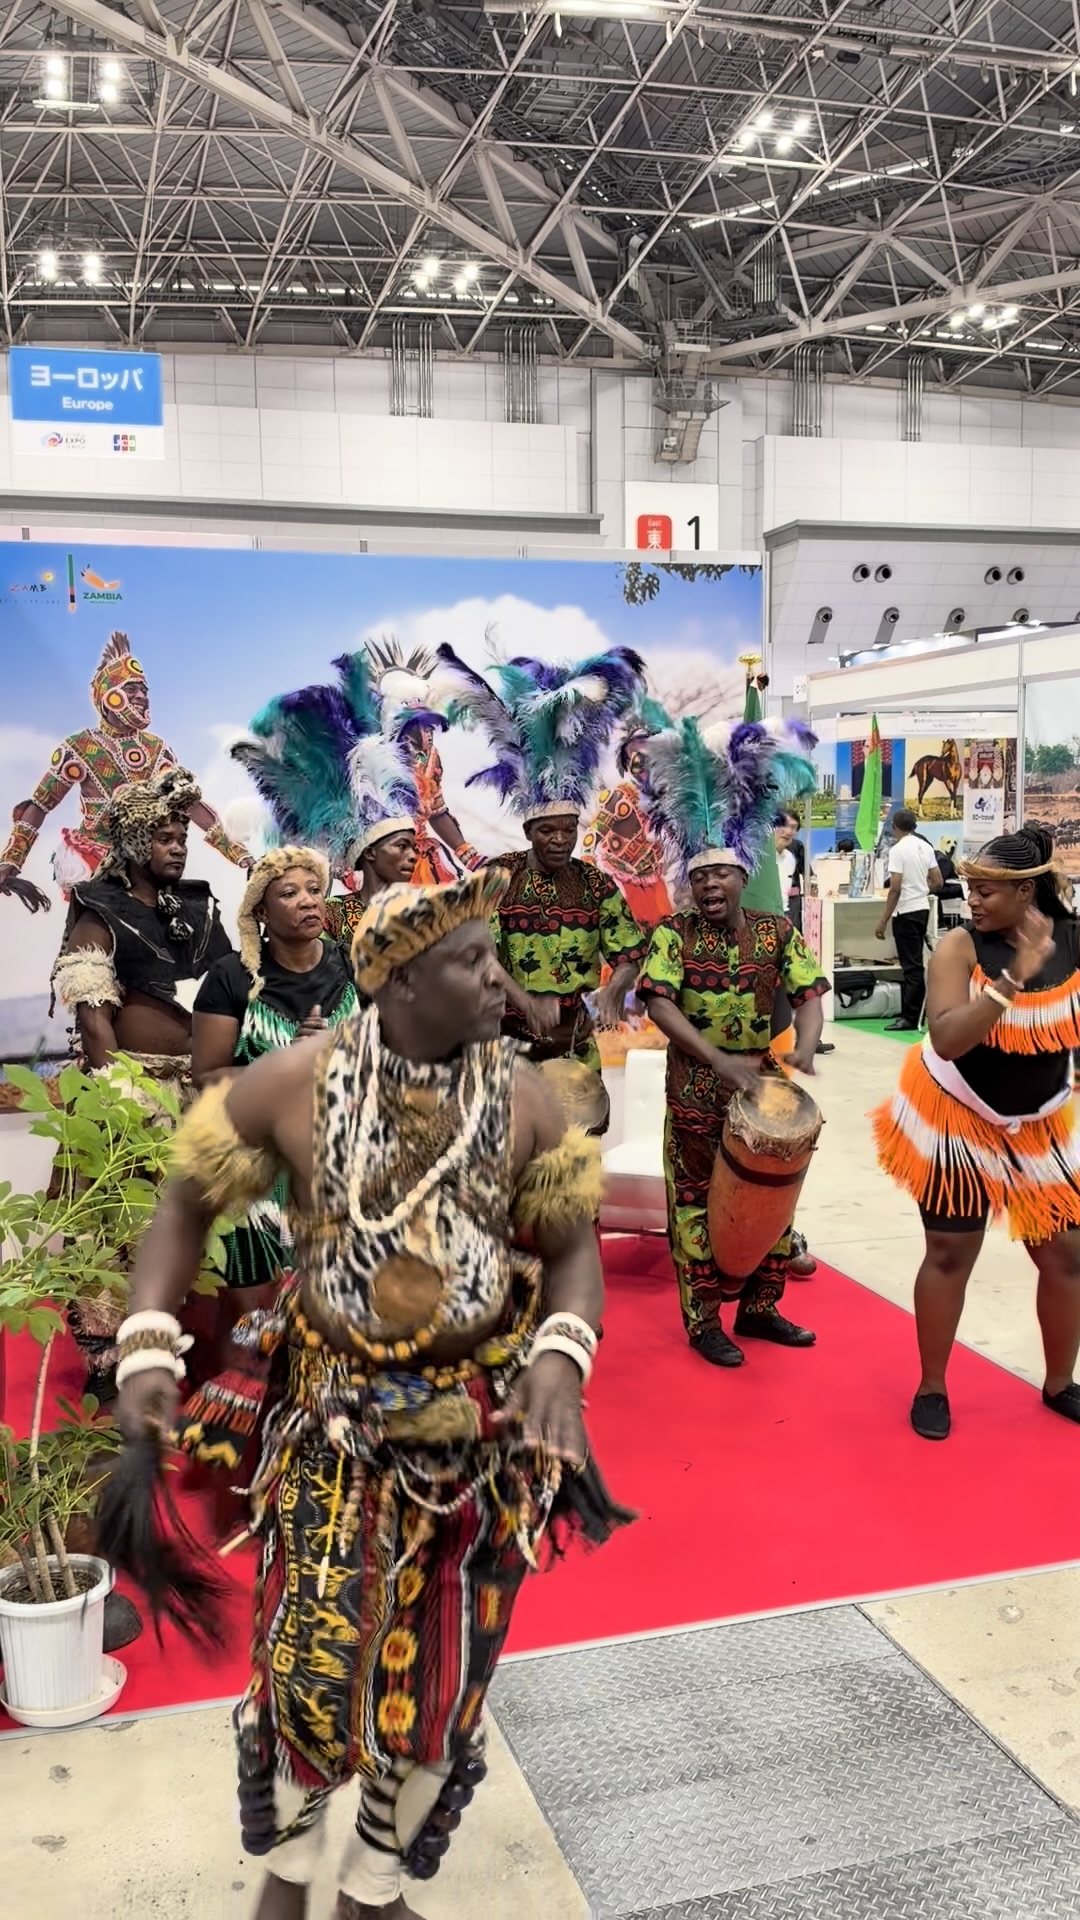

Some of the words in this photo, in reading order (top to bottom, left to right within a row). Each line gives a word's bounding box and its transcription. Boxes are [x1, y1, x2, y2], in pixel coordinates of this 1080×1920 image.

[31, 365, 143, 391] ヨーロッパ
[62, 397, 114, 411] Europe
[647, 528, 663, 549] 東
[687, 515, 700, 550] 1
[10, 583, 58, 593] ZAMB
[83, 592, 123, 601] ZAMBIA
